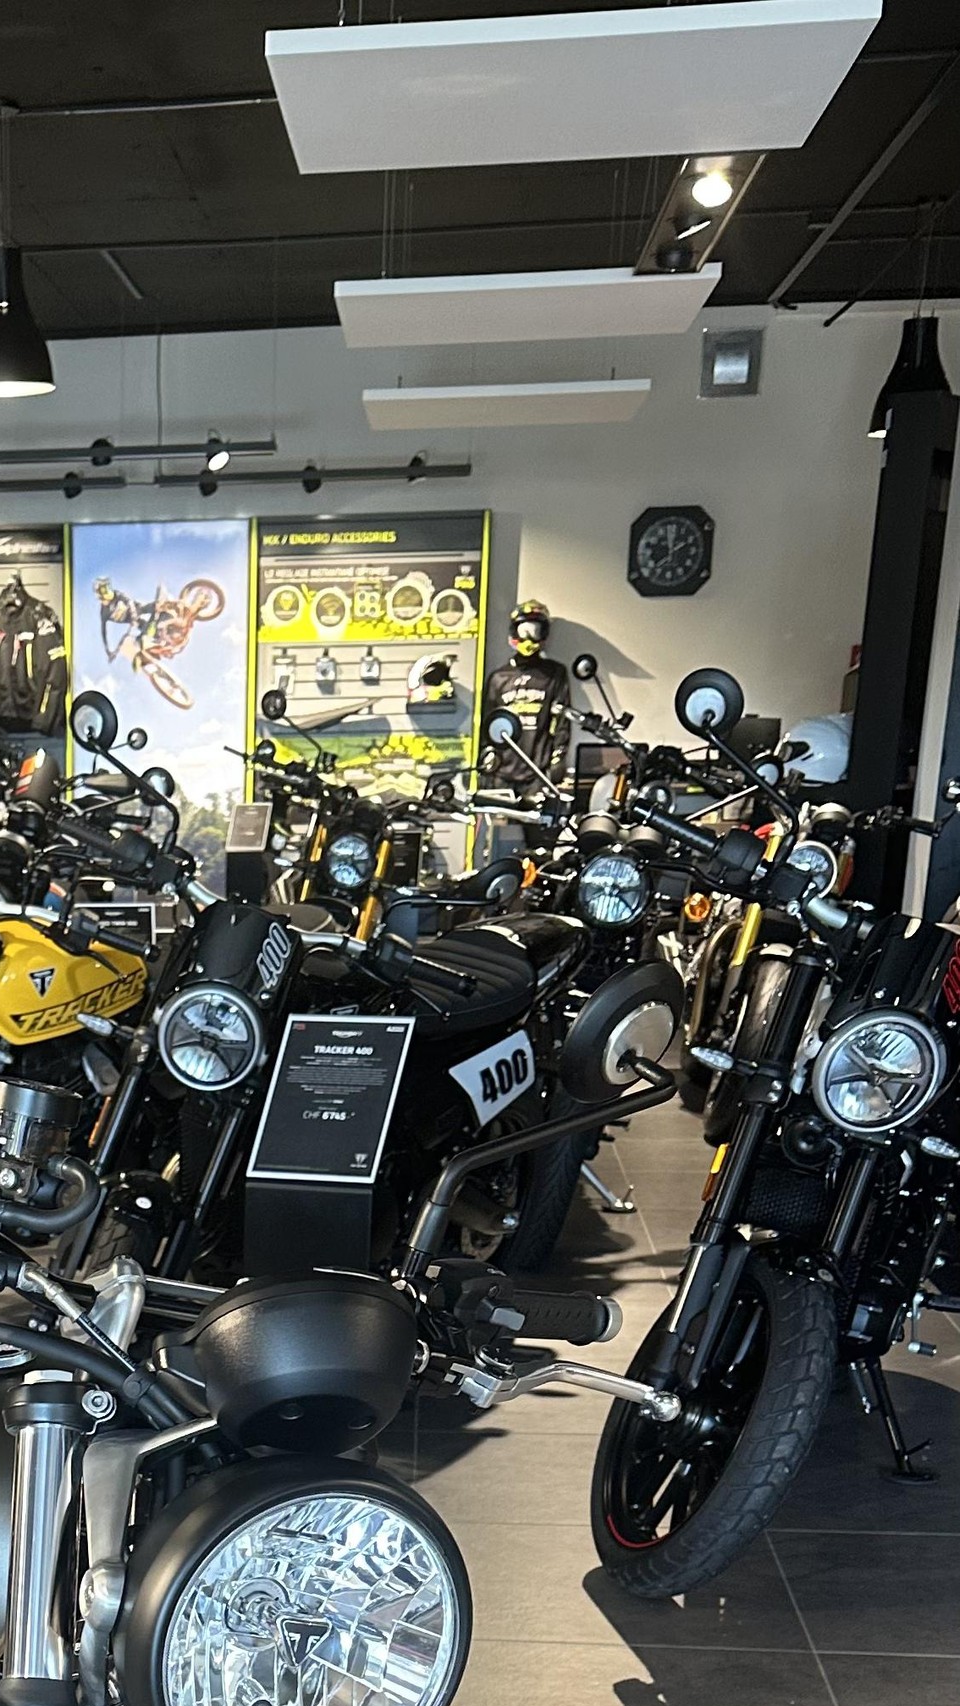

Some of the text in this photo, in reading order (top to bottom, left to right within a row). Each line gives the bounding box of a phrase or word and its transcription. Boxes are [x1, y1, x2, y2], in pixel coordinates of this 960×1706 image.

[289, 533, 330, 545] ENDURO
[256, 922, 291, 989] 400
[17, 970, 146, 1034] TRACKER
[314, 1045, 354, 1055] TRACKER
[479, 1048, 529, 1104] 400
